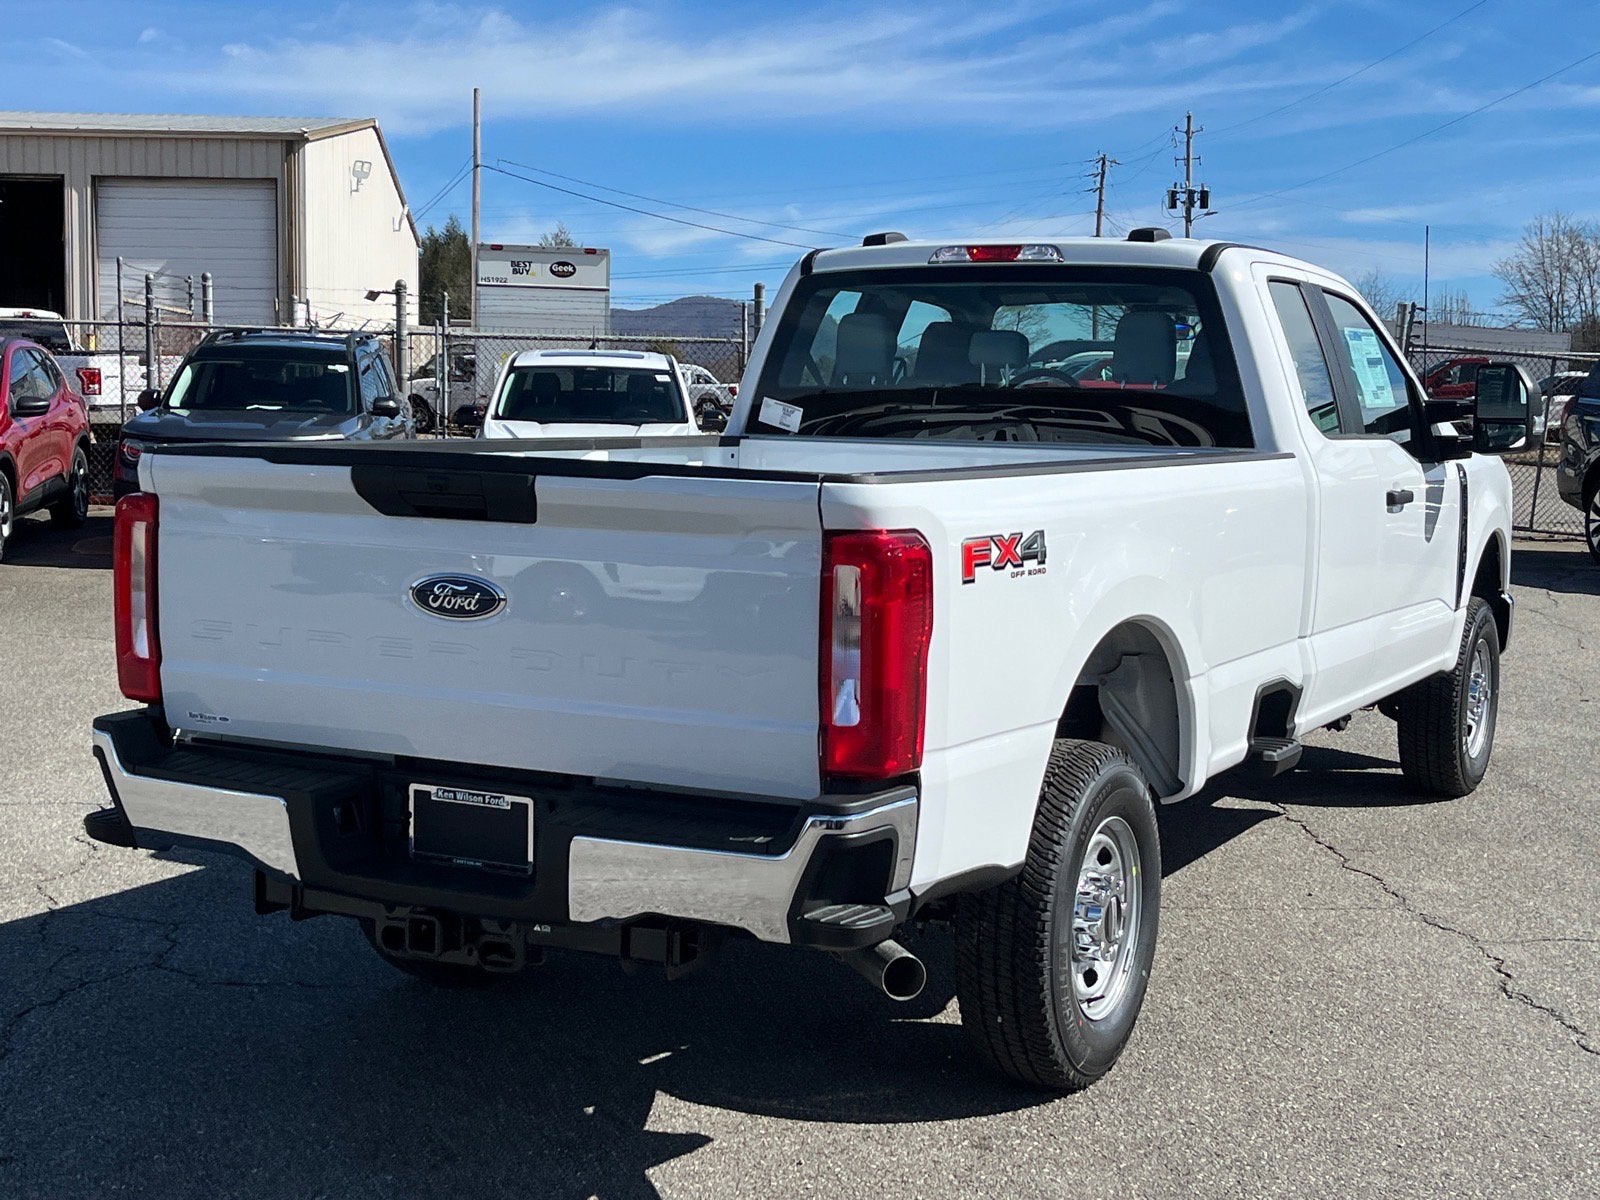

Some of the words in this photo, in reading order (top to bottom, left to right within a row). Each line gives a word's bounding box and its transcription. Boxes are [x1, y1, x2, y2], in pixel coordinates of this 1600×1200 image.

[511, 260, 532, 268] BEST
[552, 264, 574, 273] Geek
[961, 530, 1047, 585] FX4
[1028, 567, 1047, 576] ROAD
[429, 582, 481, 611] Ford
[190, 618, 481, 666] SUPER
[437, 789, 454, 799] Ken
[456, 791, 483, 803] Wilson
[485, 795, 505, 806] Ford
